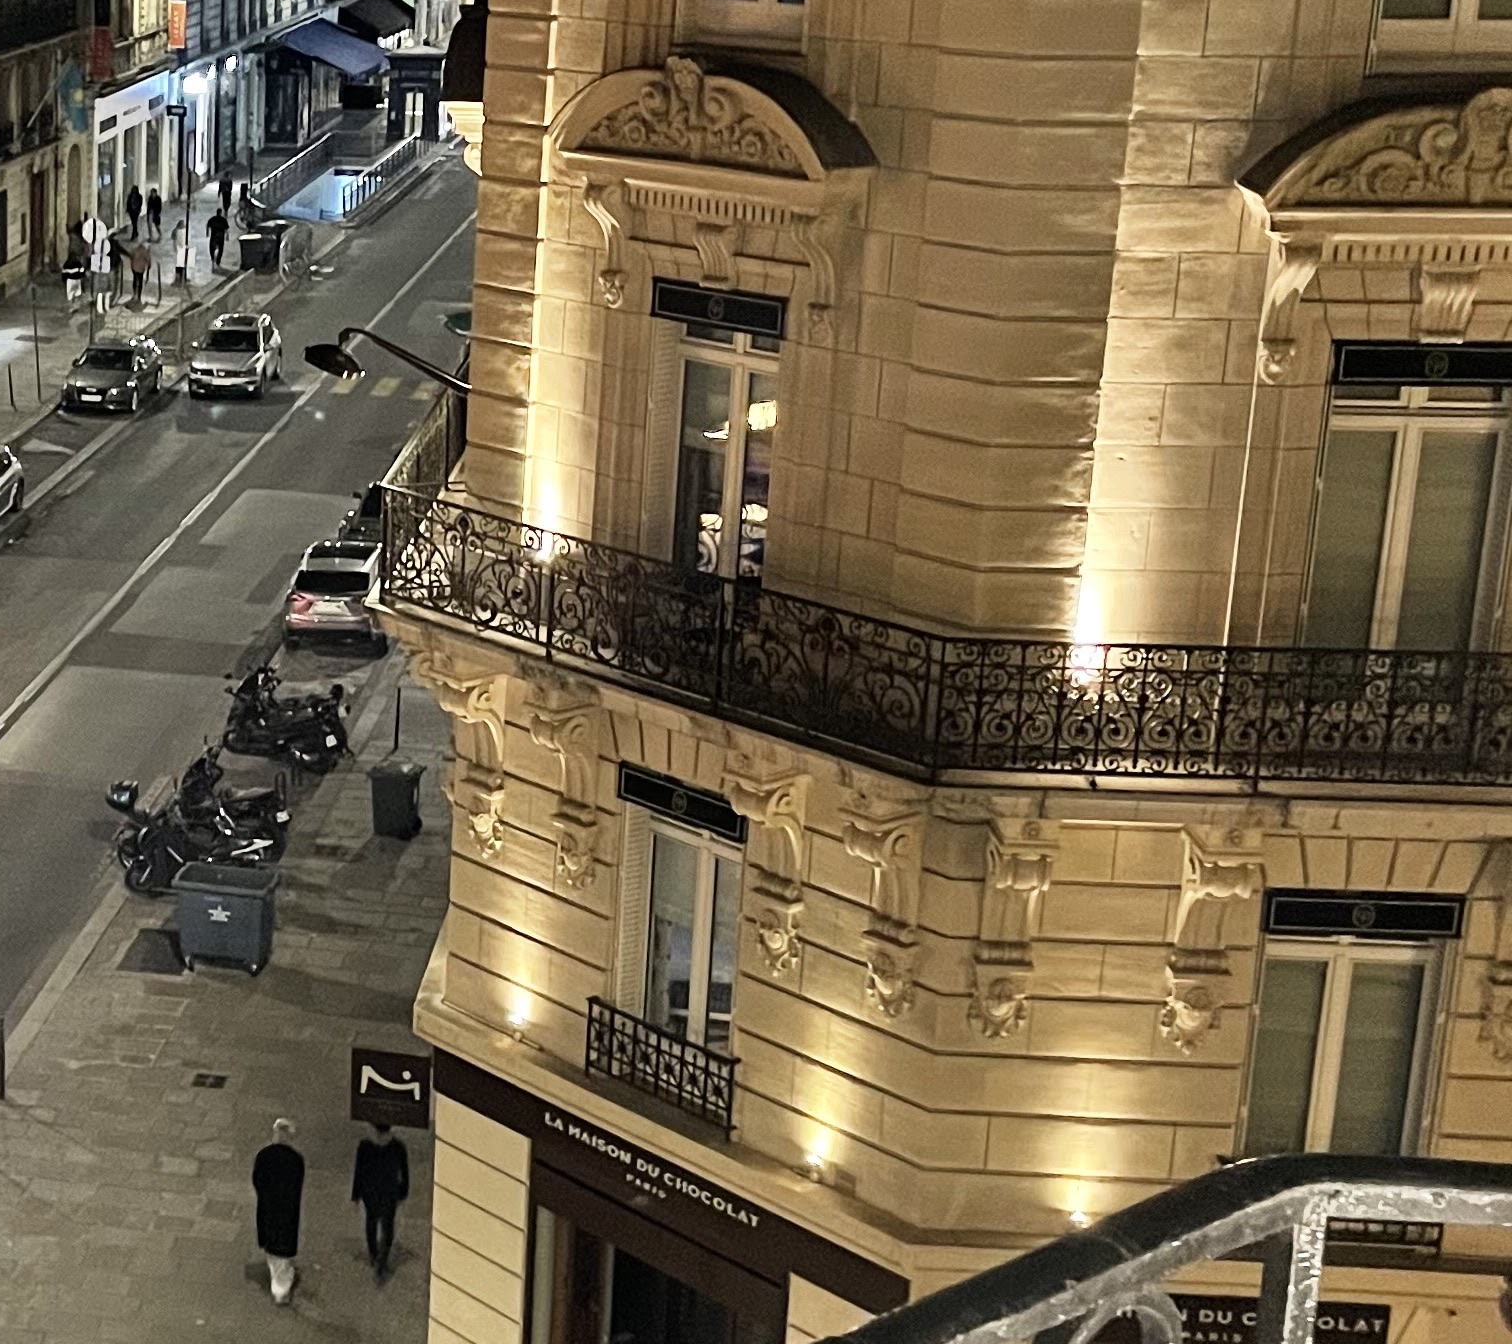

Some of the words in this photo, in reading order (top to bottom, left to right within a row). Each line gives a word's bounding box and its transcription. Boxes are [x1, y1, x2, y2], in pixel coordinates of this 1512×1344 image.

[544, 1111, 565, 1131] LA
[568, 1123, 632, 1166] MAISON
[636, 1158, 661, 1179] DU
[663, 1171, 761, 1228] CHOCOLAT
[625, 1172, 668, 1200] PARIS
[1198, 1308, 1233, 1325] DU
